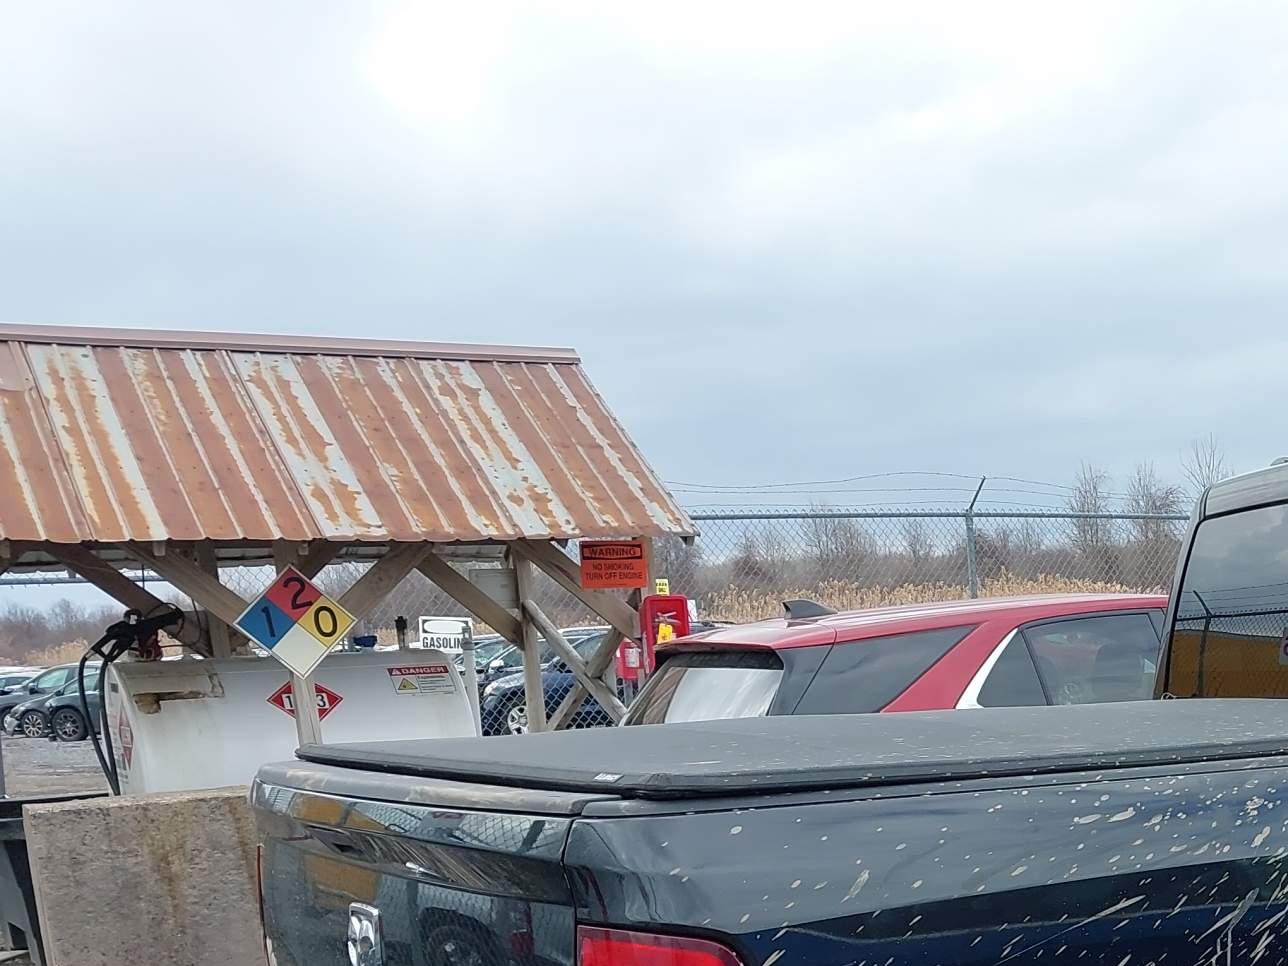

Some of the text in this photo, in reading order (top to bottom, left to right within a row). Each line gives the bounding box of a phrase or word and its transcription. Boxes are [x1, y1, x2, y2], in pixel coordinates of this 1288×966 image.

[589, 547, 636, 557] WARNING
[592, 562, 634, 571] NO SMOKING
[586, 572, 643, 580] TURN OFF ENGINE
[283, 576, 313, 609] 2
[261, 606, 276, 638] 1
[314, 606, 338, 637] 0
[422, 636, 463, 649] GASOLIN
[401, 666, 444, 675] DANGER
